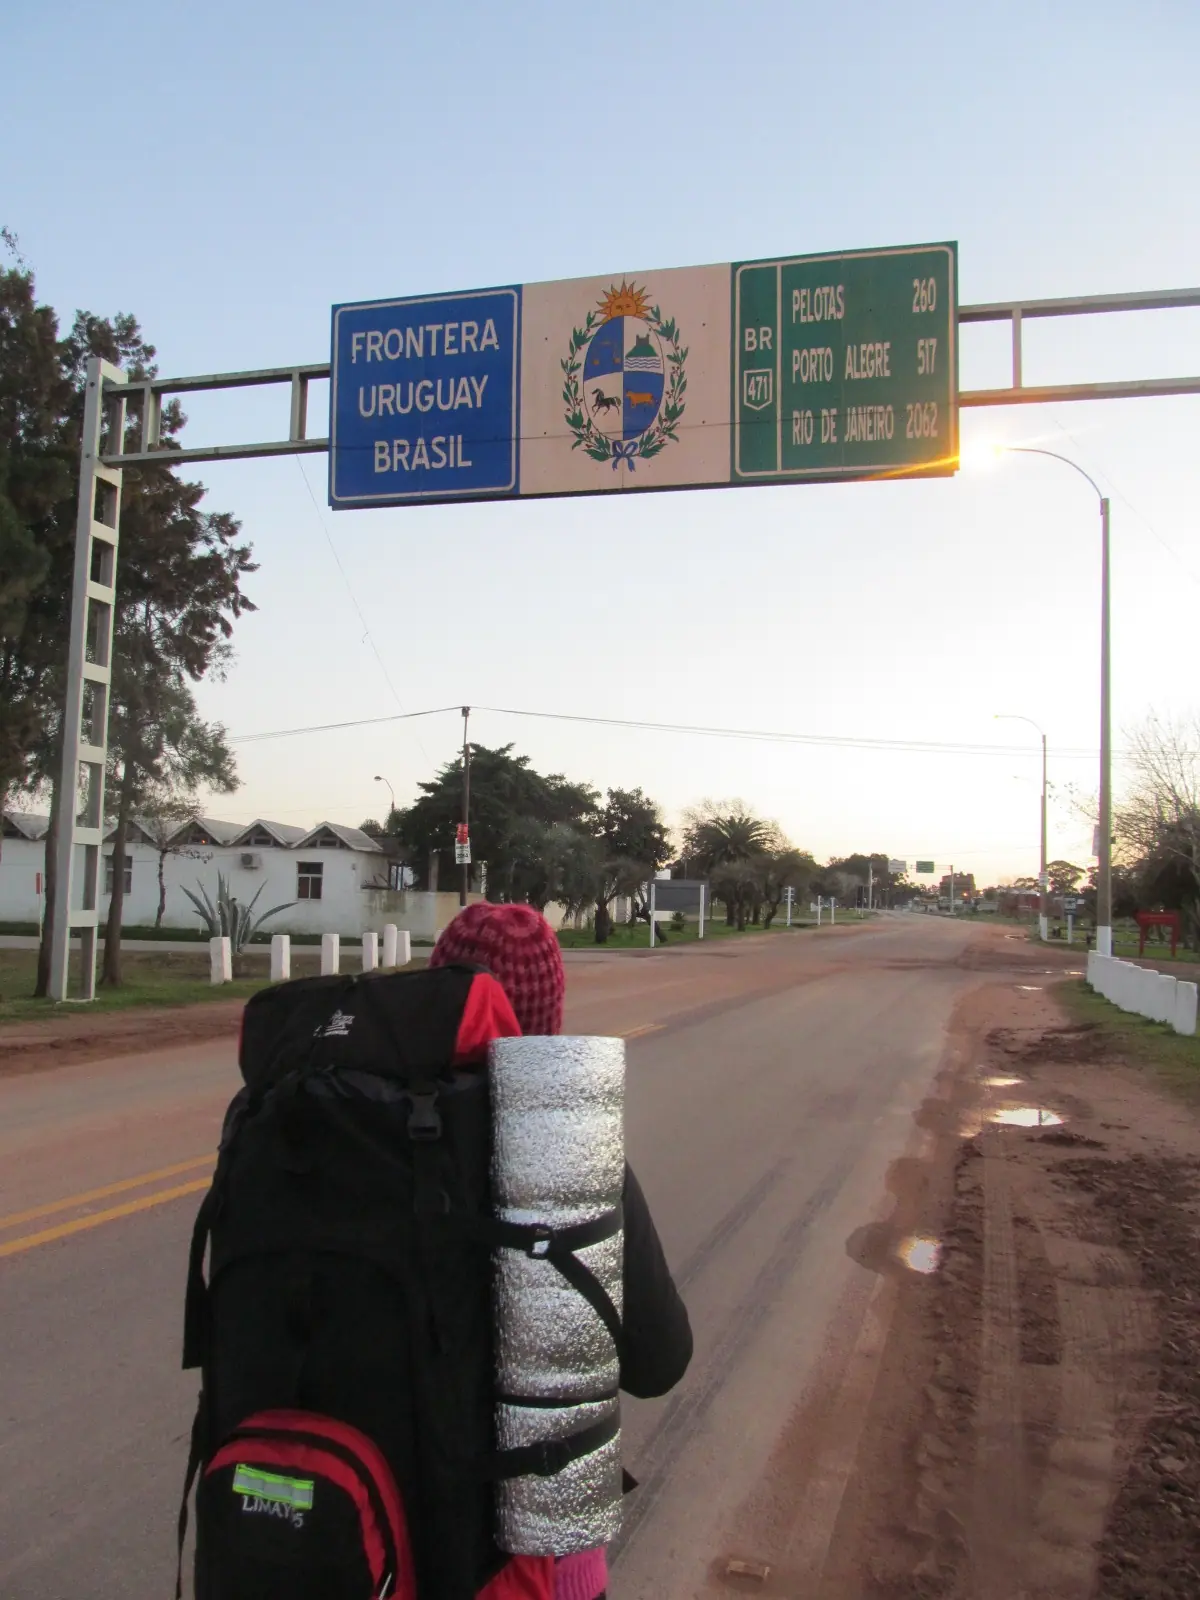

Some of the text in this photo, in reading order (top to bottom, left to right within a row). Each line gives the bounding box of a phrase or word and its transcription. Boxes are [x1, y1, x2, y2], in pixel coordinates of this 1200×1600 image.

[792, 277, 937, 324] PELOTAS 260
[351, 318, 500, 364] FRONTERA
[744, 326, 773, 351] BR
[792, 338, 938, 384] PORTO ALEGRE 517
[358, 374, 489, 418] URUGUAY
[748, 376, 768, 401] 471
[792, 402, 939, 446] RIO DE JANEIRO 2062
[374, 434, 473, 473] BRASIL
[242, 1494, 291, 1519] LIMAY
